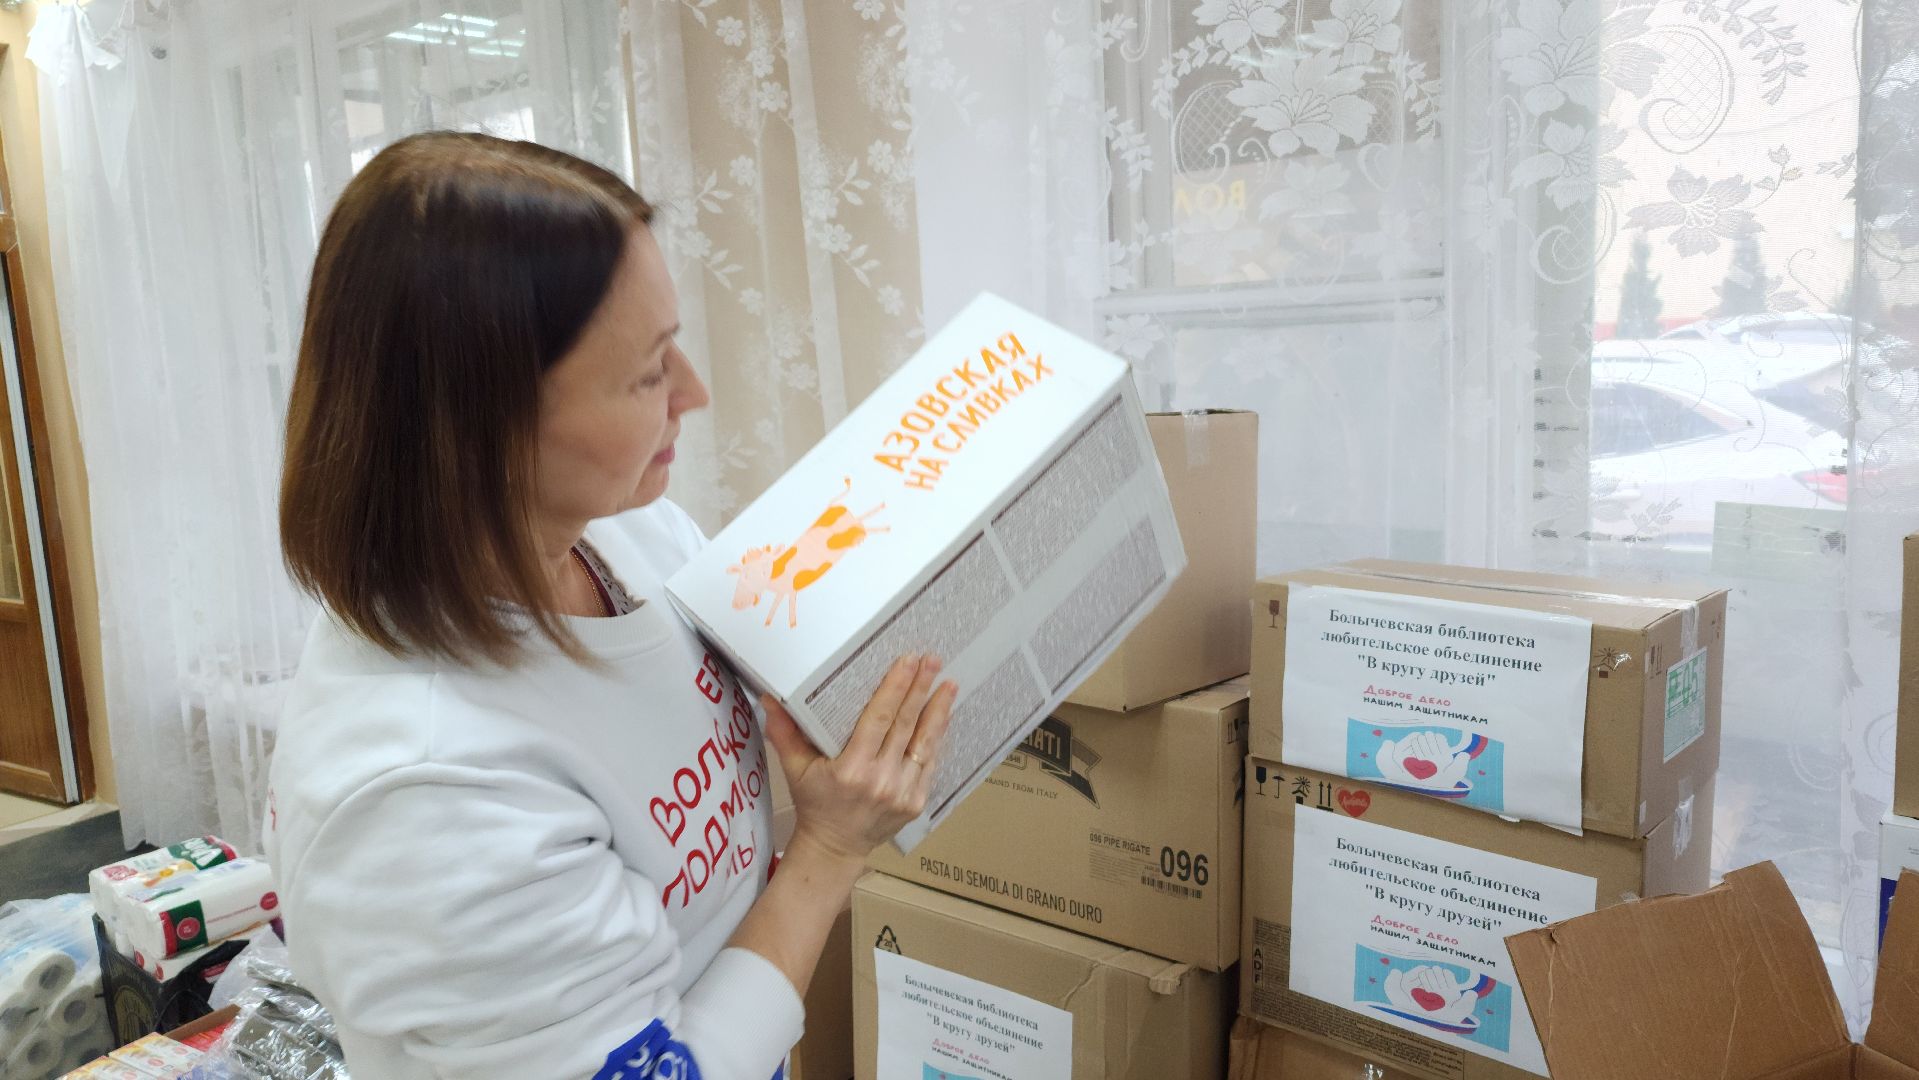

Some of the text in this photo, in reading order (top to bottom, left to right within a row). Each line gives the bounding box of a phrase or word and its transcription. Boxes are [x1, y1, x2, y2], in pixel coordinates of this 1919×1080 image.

[873, 331, 1026, 473] АЗОВСКАЯ
[904, 353, 1054, 491] НА СЛИВКАХ
[1329, 609, 1535, 649] Болычевская библиотека
[1321, 631, 1542, 672] любительское объединение
[1358, 654, 1496, 686] "В кругу друзей"
[695, 652, 724, 704] ЕР
[1363, 684, 1451, 707] ДОБРОЕ ДЕЛО
[1363, 697, 1488, 725] НАШИМ ЗАЩИТНИКАМ
[1012, 783, 1034, 793] FROM
[1036, 787, 1058, 799] ITALY
[1090, 833, 1151, 856] 096 PIPE RIGATE
[1160, 846, 1209, 886] 096
[1336, 836, 1541, 902] Болычевская библиотека
[921, 856, 1103, 924] PASTA DI SEMOLA DI GRANO DURO
[1329, 857, 1548, 925] любительское объединение
[1365, 883, 1502, 931] "В кругу друзей"
[1370, 914, 1459, 946] ДОБРОЕ ДЕЛО
[1370, 925, 1497, 968] НАШИМ ЗАЩИТНИКАМ
[901, 990, 1044, 1050] любительское объединение
[904, 974, 1039, 1031] Болычевская библиотека
[926, 1012, 1015, 1053] "В кругу друзей"
